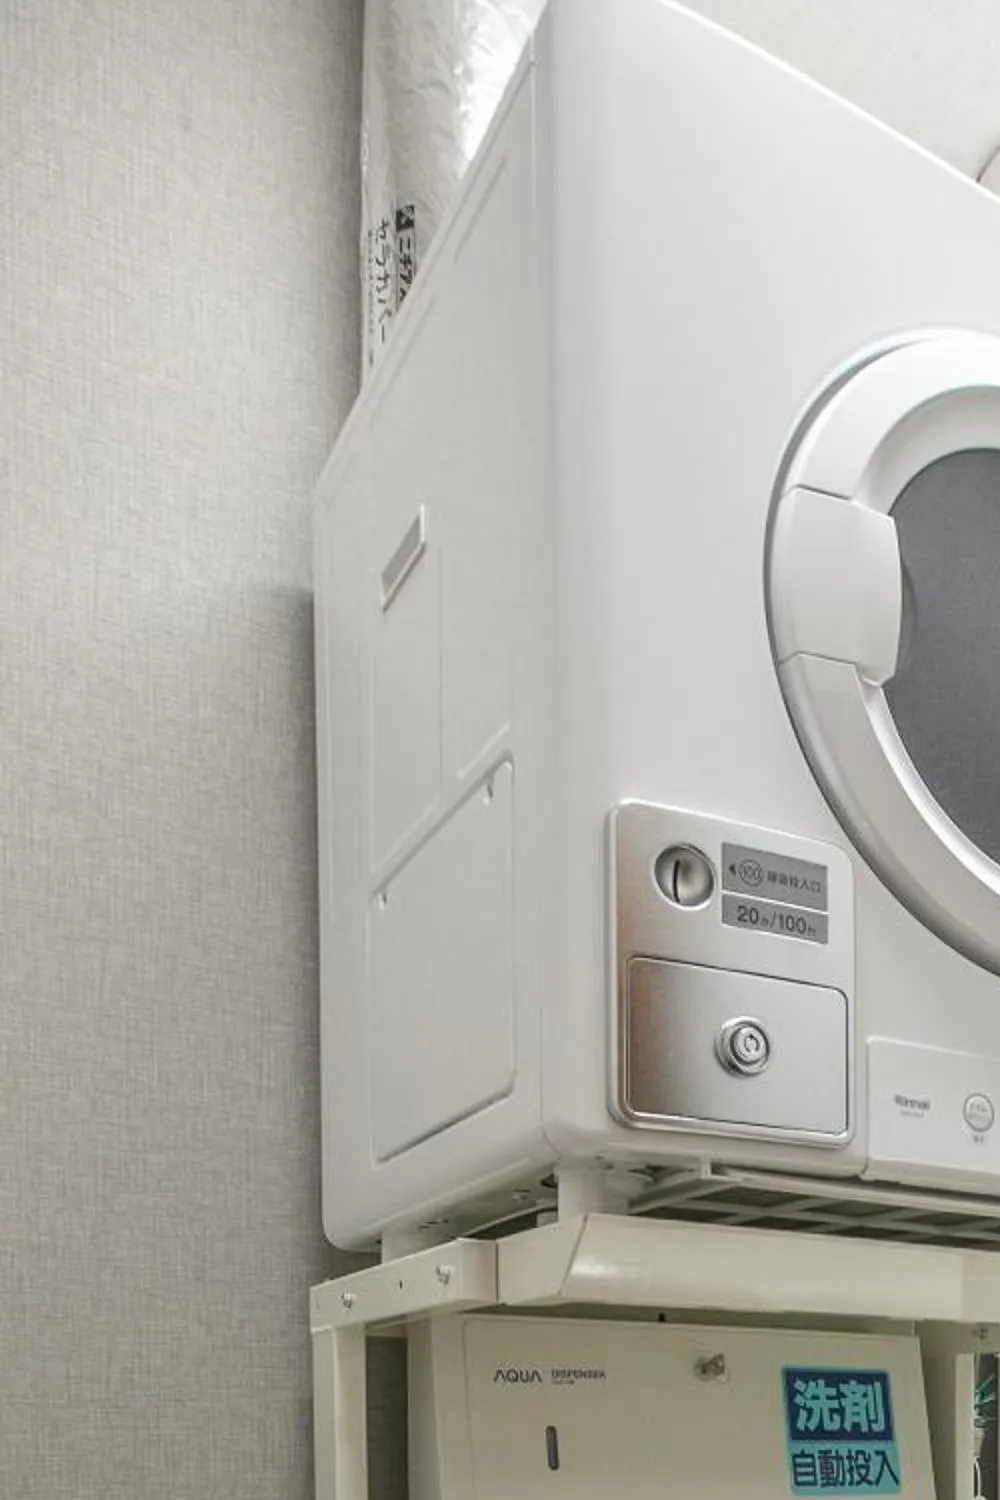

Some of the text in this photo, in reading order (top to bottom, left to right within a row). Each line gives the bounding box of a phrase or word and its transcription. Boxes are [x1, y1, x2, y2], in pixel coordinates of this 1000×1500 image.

[493, 1368, 543, 1384] AQUA
[794, 1379, 885, 1433] 洗剤
[792, 1448, 899, 1488] 自動投入
